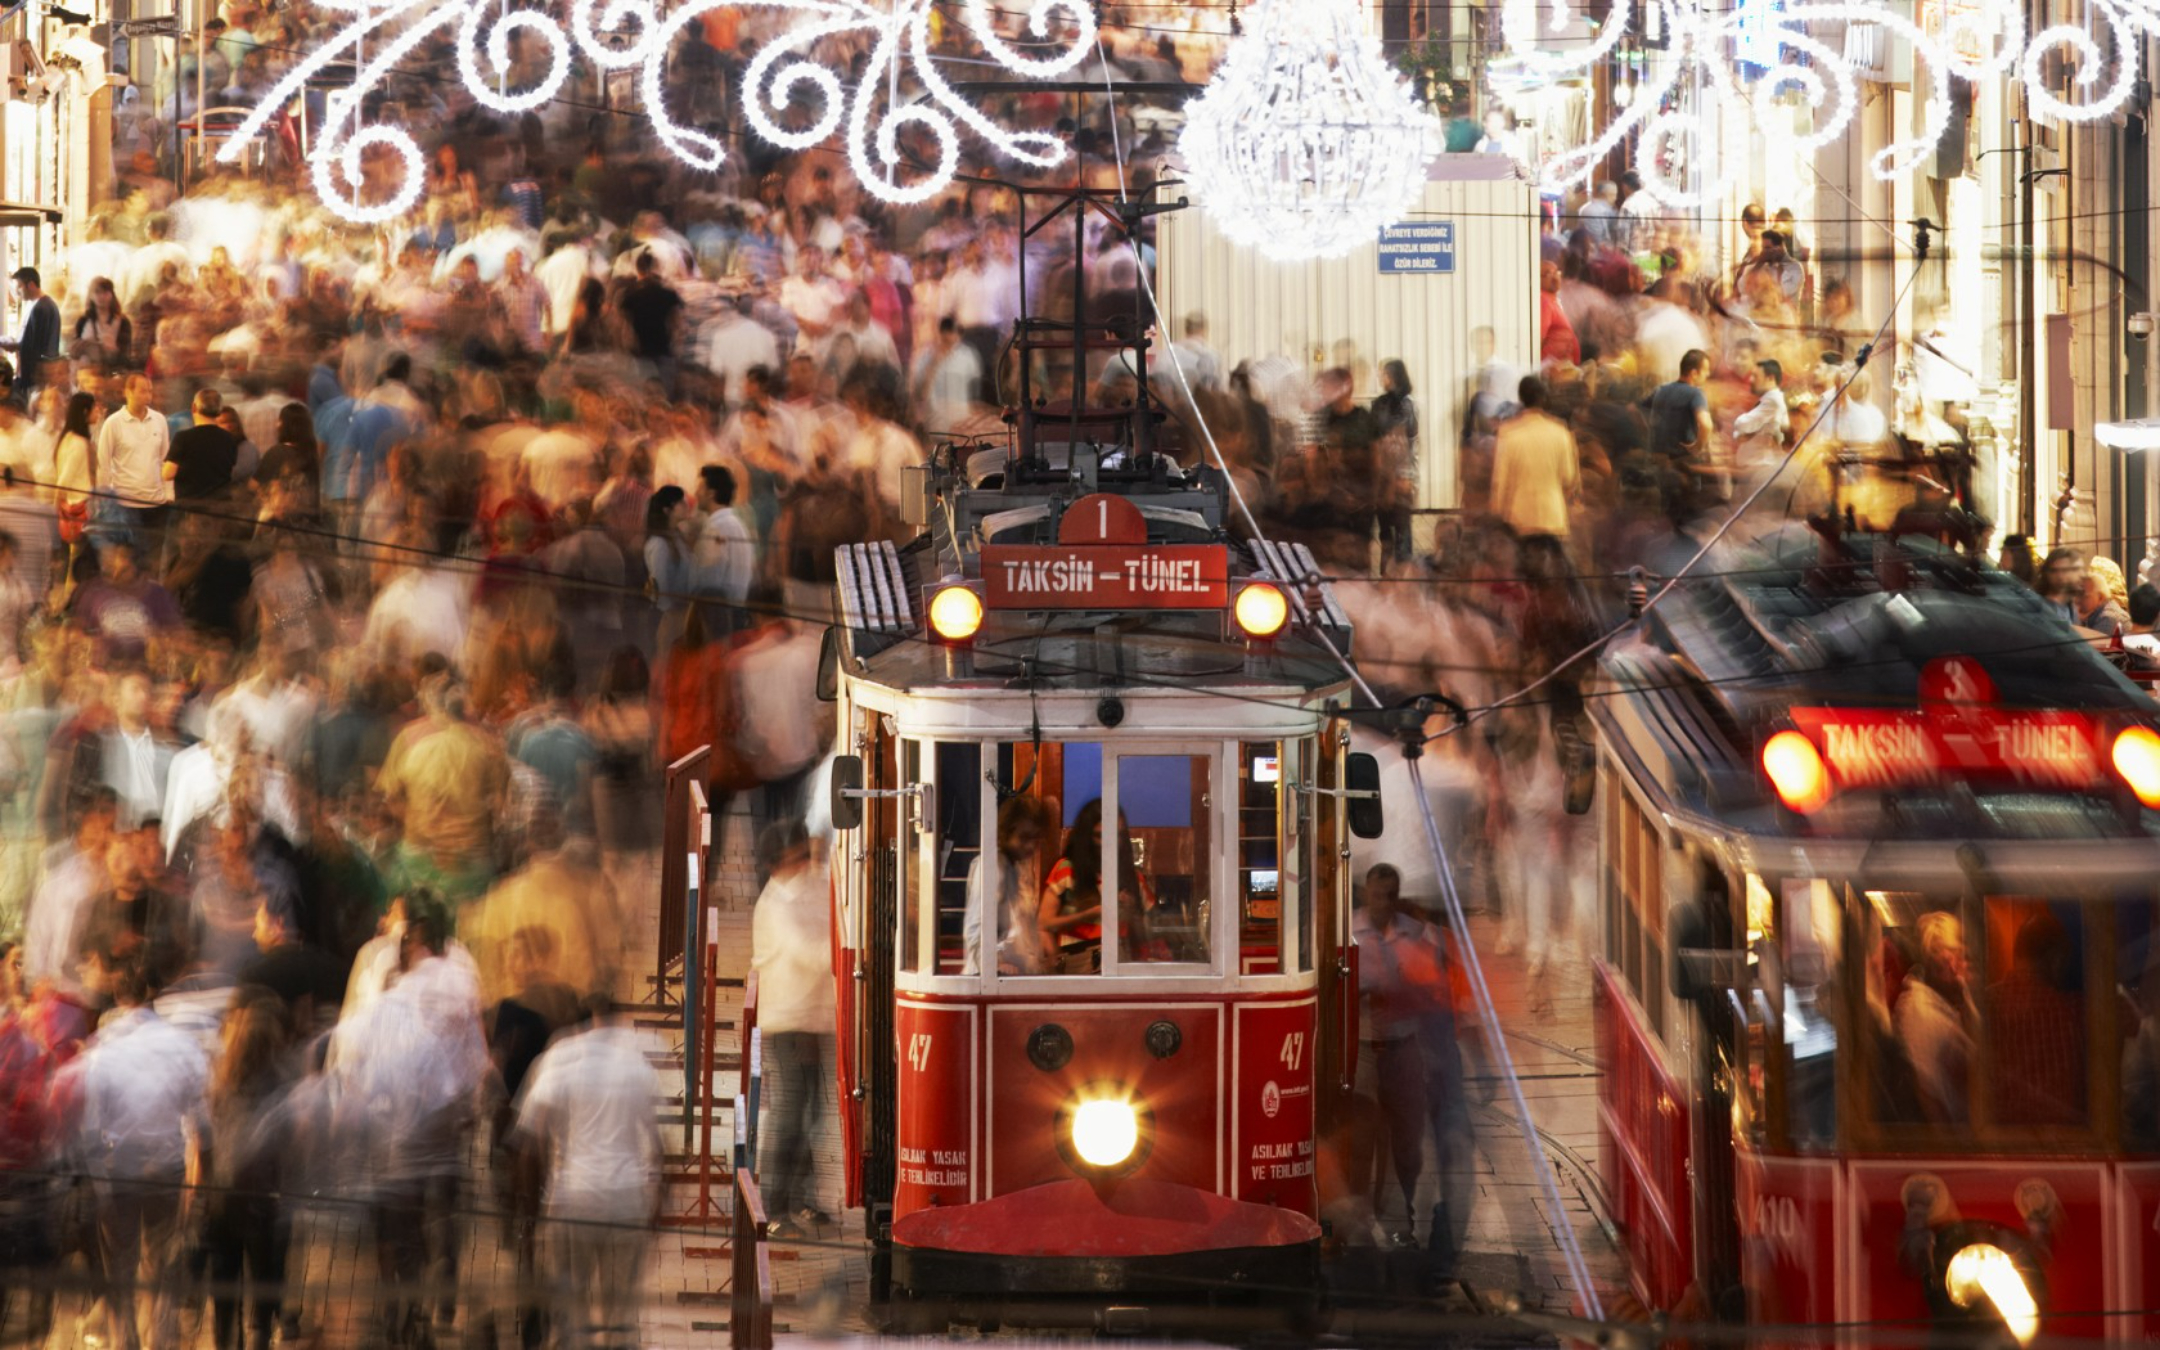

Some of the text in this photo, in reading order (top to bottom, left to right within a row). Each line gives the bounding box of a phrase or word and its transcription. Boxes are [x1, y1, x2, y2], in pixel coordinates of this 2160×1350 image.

[1098, 500, 1107, 539] 1
[1003, 555, 1093, 592] TAKSİM
[1125, 555, 1210, 592] TÜNEL
[1994, 718, 2089, 760] TÜNEL
[908, 1033, 932, 1072] 47
[1280, 1031, 1304, 1071] 47
[932, 1150, 966, 1165] YASAK
[1251, 1143, 1293, 1160] ASILMAK
[1251, 1165, 1266, 1180] VE
